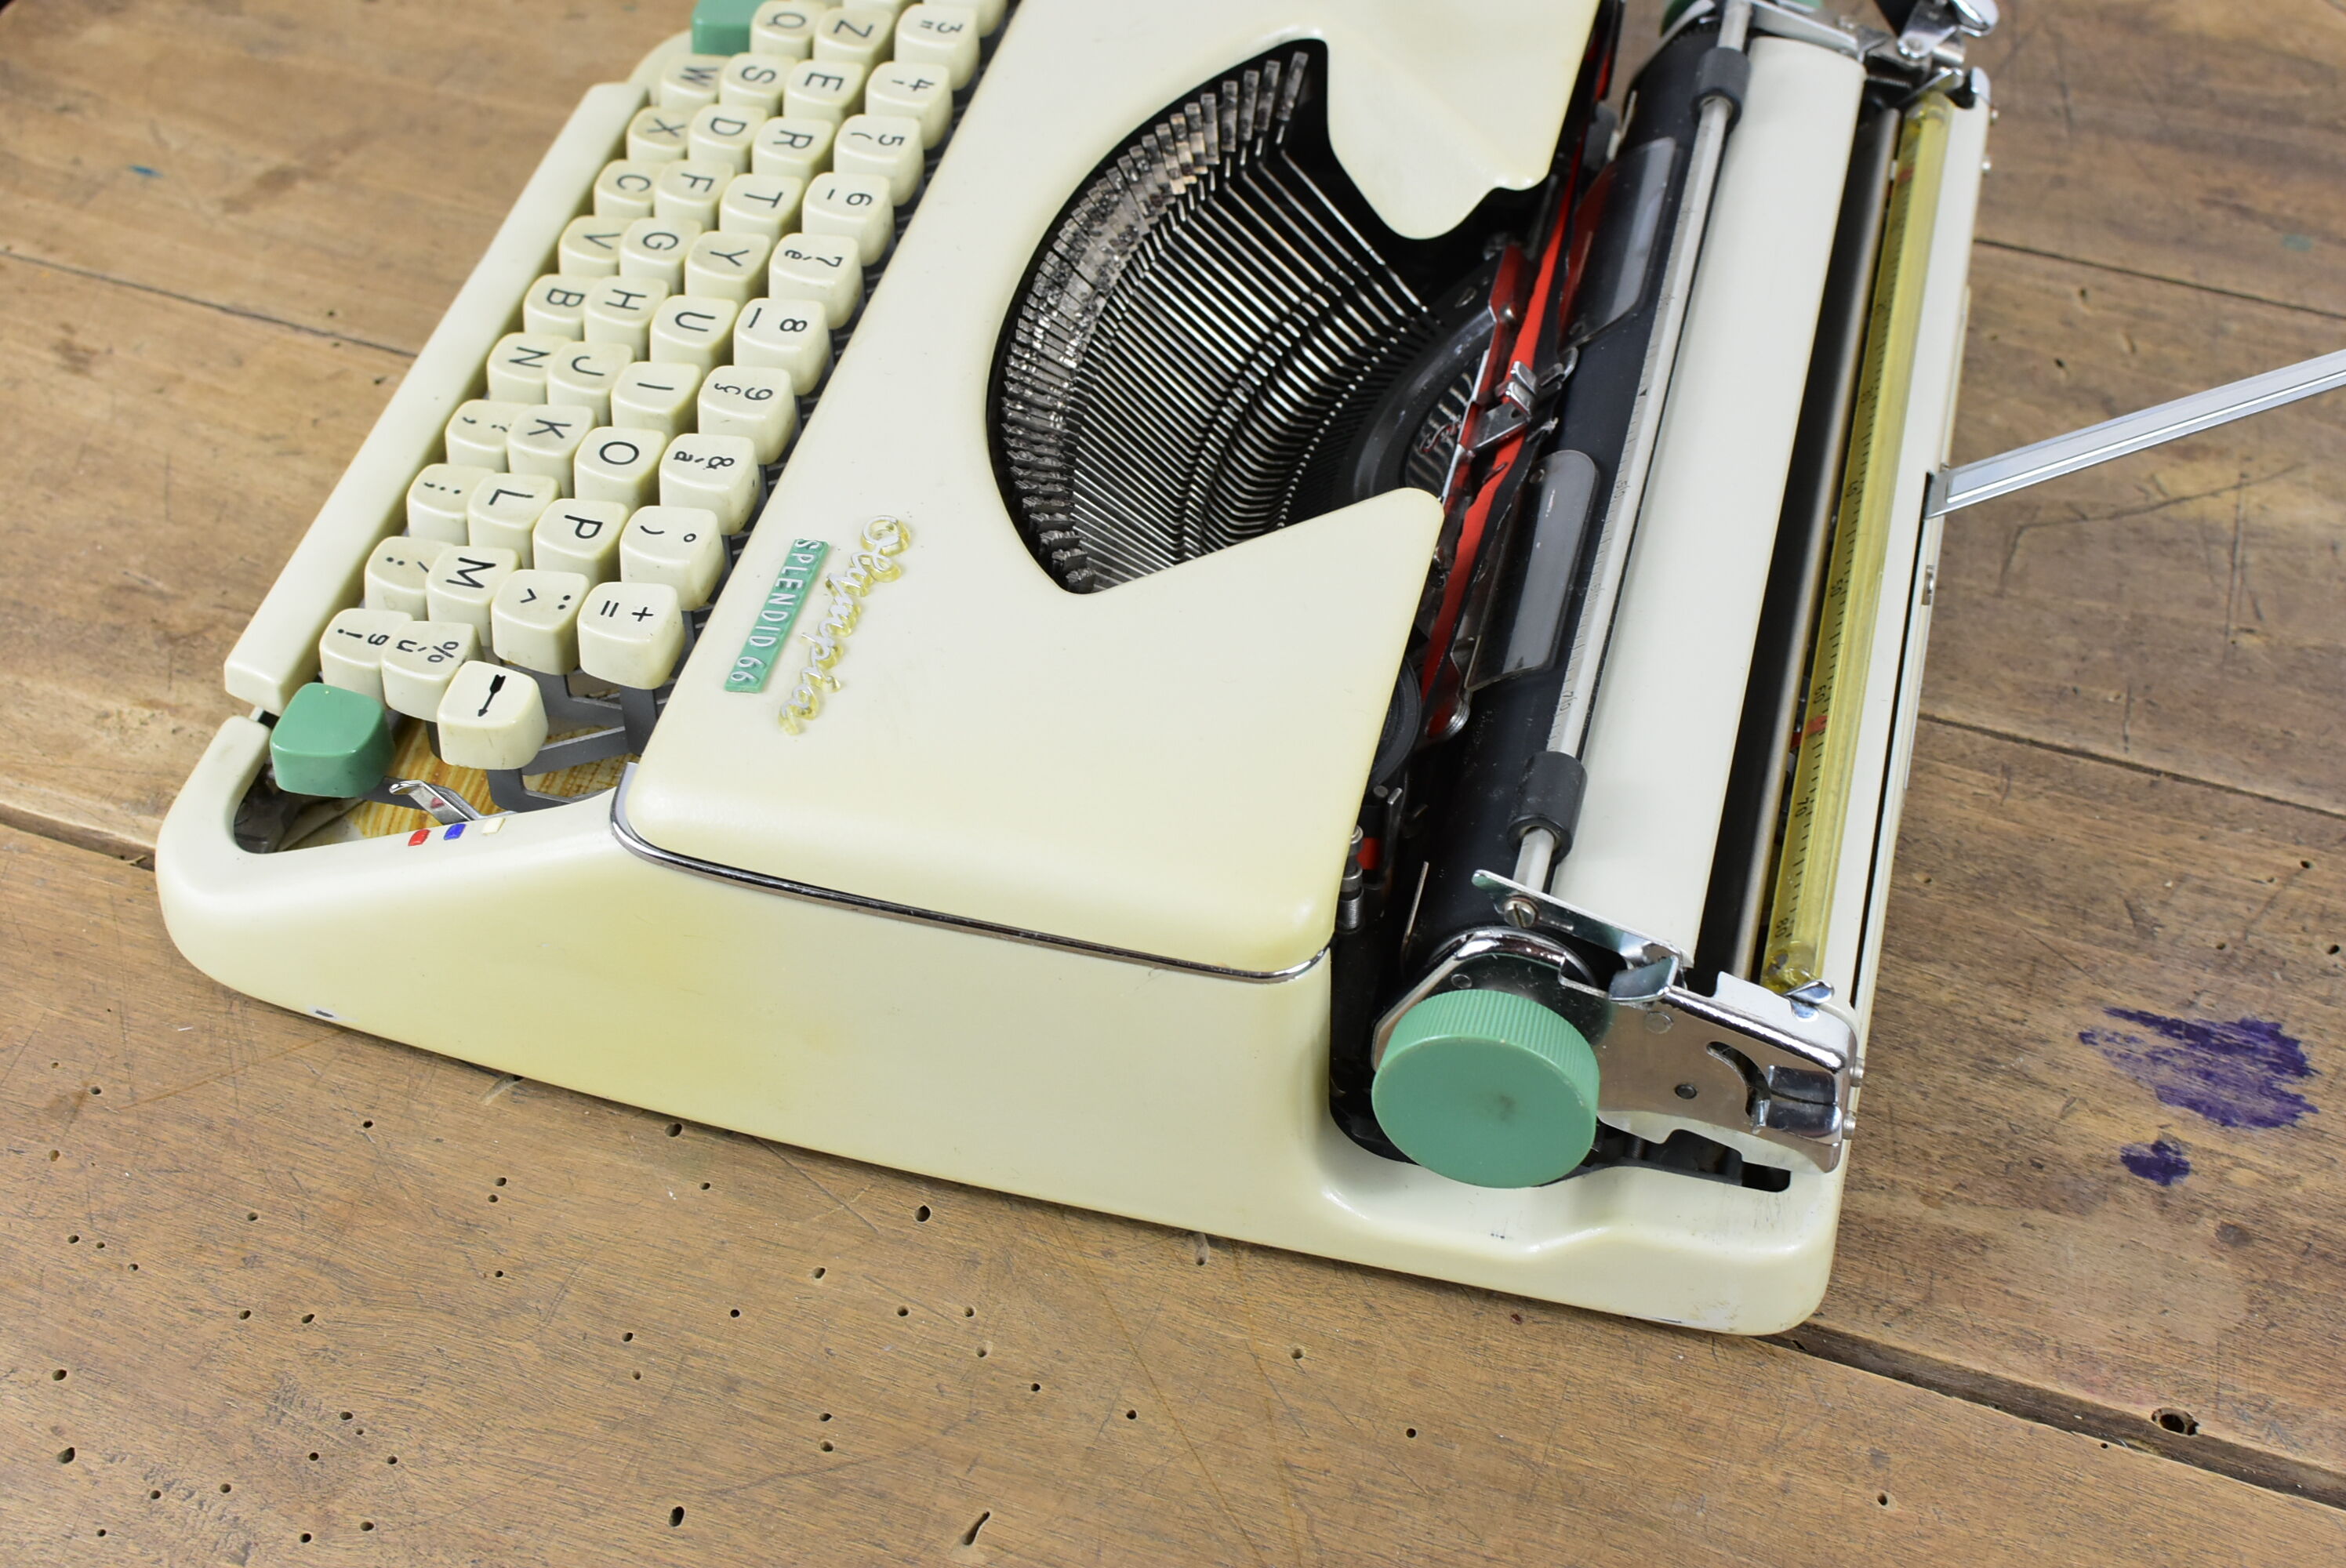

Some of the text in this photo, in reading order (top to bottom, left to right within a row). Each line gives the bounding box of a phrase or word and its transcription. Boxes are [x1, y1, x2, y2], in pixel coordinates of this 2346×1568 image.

[766, 12, 807, 29] Q
[833, 19, 874, 38] Z
[936, 22, 964, 34] 3
[680, 67, 717, 86] W
[740, 66, 777, 84] S
[804, 72, 844, 92] E
[909, 78, 935, 92] 4
[647, 118, 686, 138] X
[710, 117, 747, 136] D
[772, 130, 814, 150] R
[877, 134, 906, 147] 5
[616, 174, 652, 192] C
[681, 172, 715, 193] F
[744, 191, 783, 209] T
[845, 192, 873, 206] 6
[583, 233, 622, 250] V
[641, 231, 680, 251] G
[709, 249, 750, 267] Y
[815, 256, 844, 268] 7
[546, 288, 586, 308] B
[605, 289, 647, 310] H
[674, 311, 716, 332] U
[779, 318, 808, 332] 8
[508, 347, 551, 368] N
[571, 355, 605, 377] J
[744, 387, 774, 401] 9
[527, 419, 572, 439] K
[599, 441, 640, 466] O
[488, 488, 534, 506] L
[564, 514, 604, 539] P
[445, 557, 496, 589] M
[731, 539, 821, 683] SPLENDID 66
[779, 515, 908, 732] Olympia
[427, 641, 459, 663] %
[1796, 797, 1810, 818] 70
[1775, 917, 1790, 938] 80
